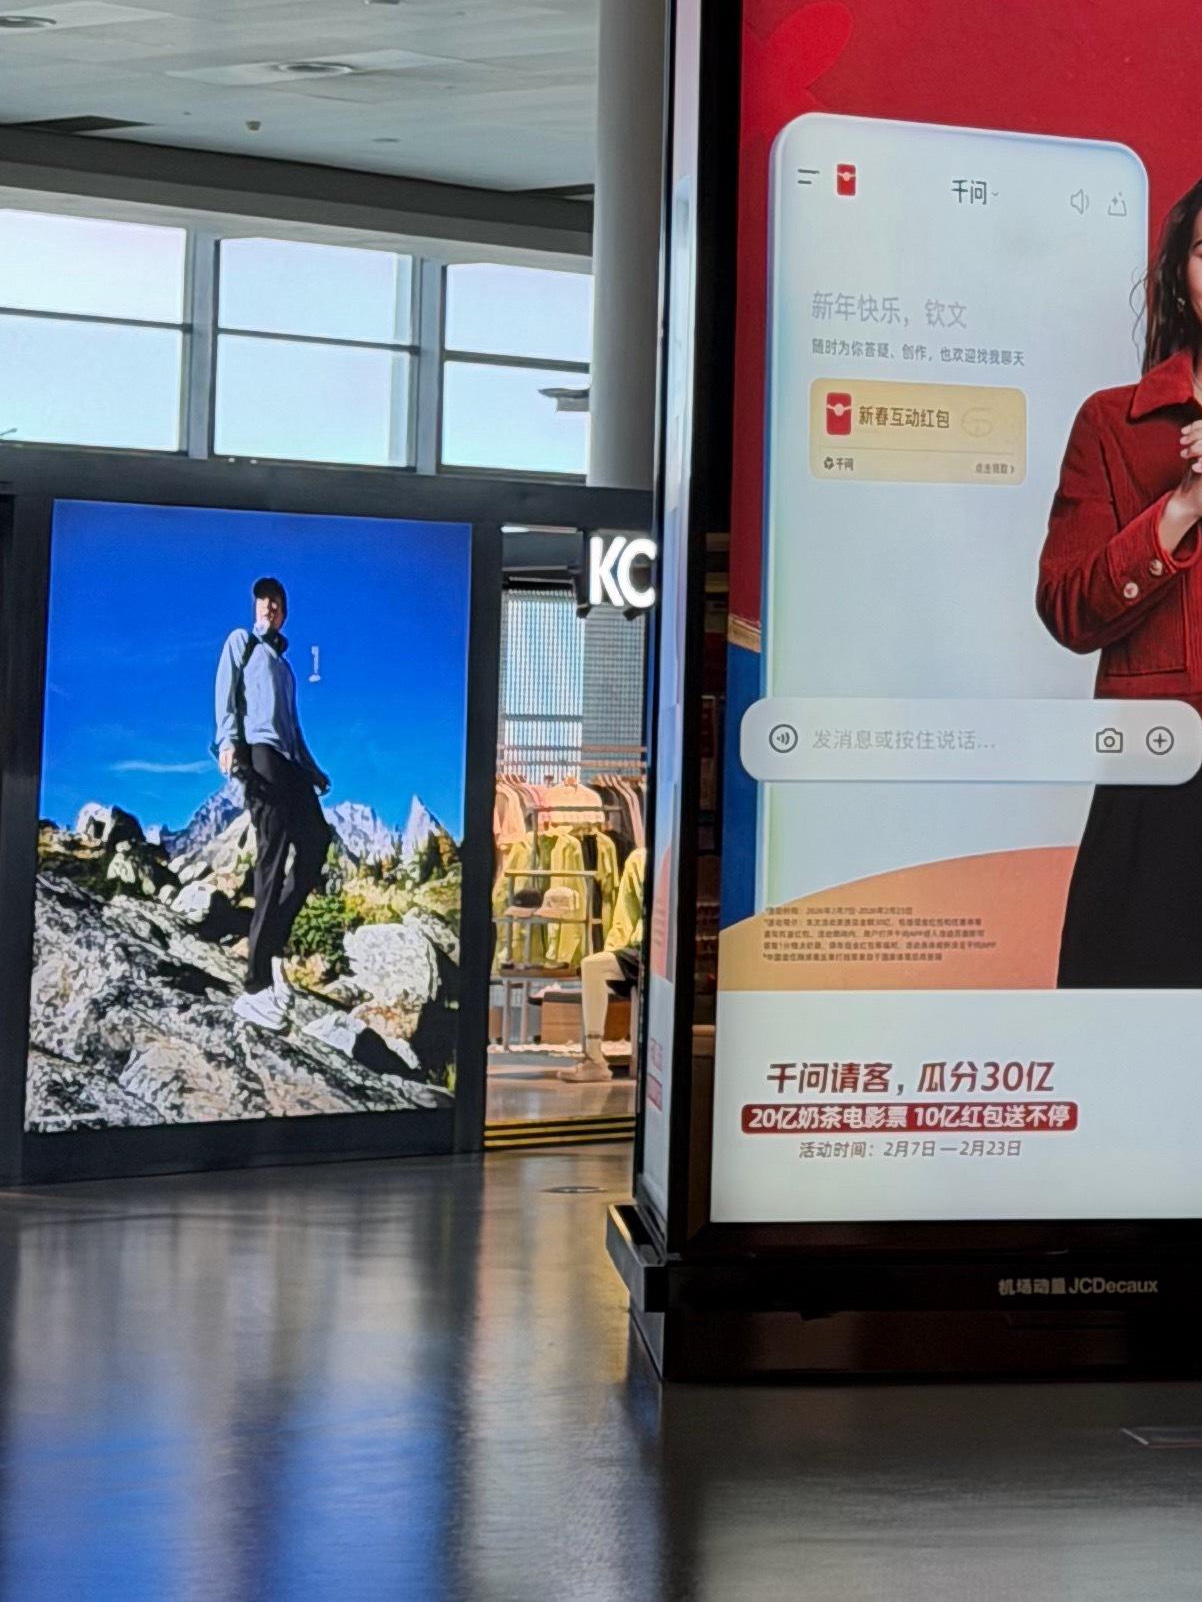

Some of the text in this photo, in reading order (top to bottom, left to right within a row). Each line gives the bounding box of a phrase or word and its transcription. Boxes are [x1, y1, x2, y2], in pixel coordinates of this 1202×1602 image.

[951, 179, 989, 206] 千问
[858, 405, 950, 429] 新春互动红包
[766, 1061, 1055, 1096] 千问请客，瓜分30亿
[749, 1103, 1071, 1130] 20亿奶茶电影票 10亿红包送不停
[1068, 1277, 1159, 1295] JCDecaux
